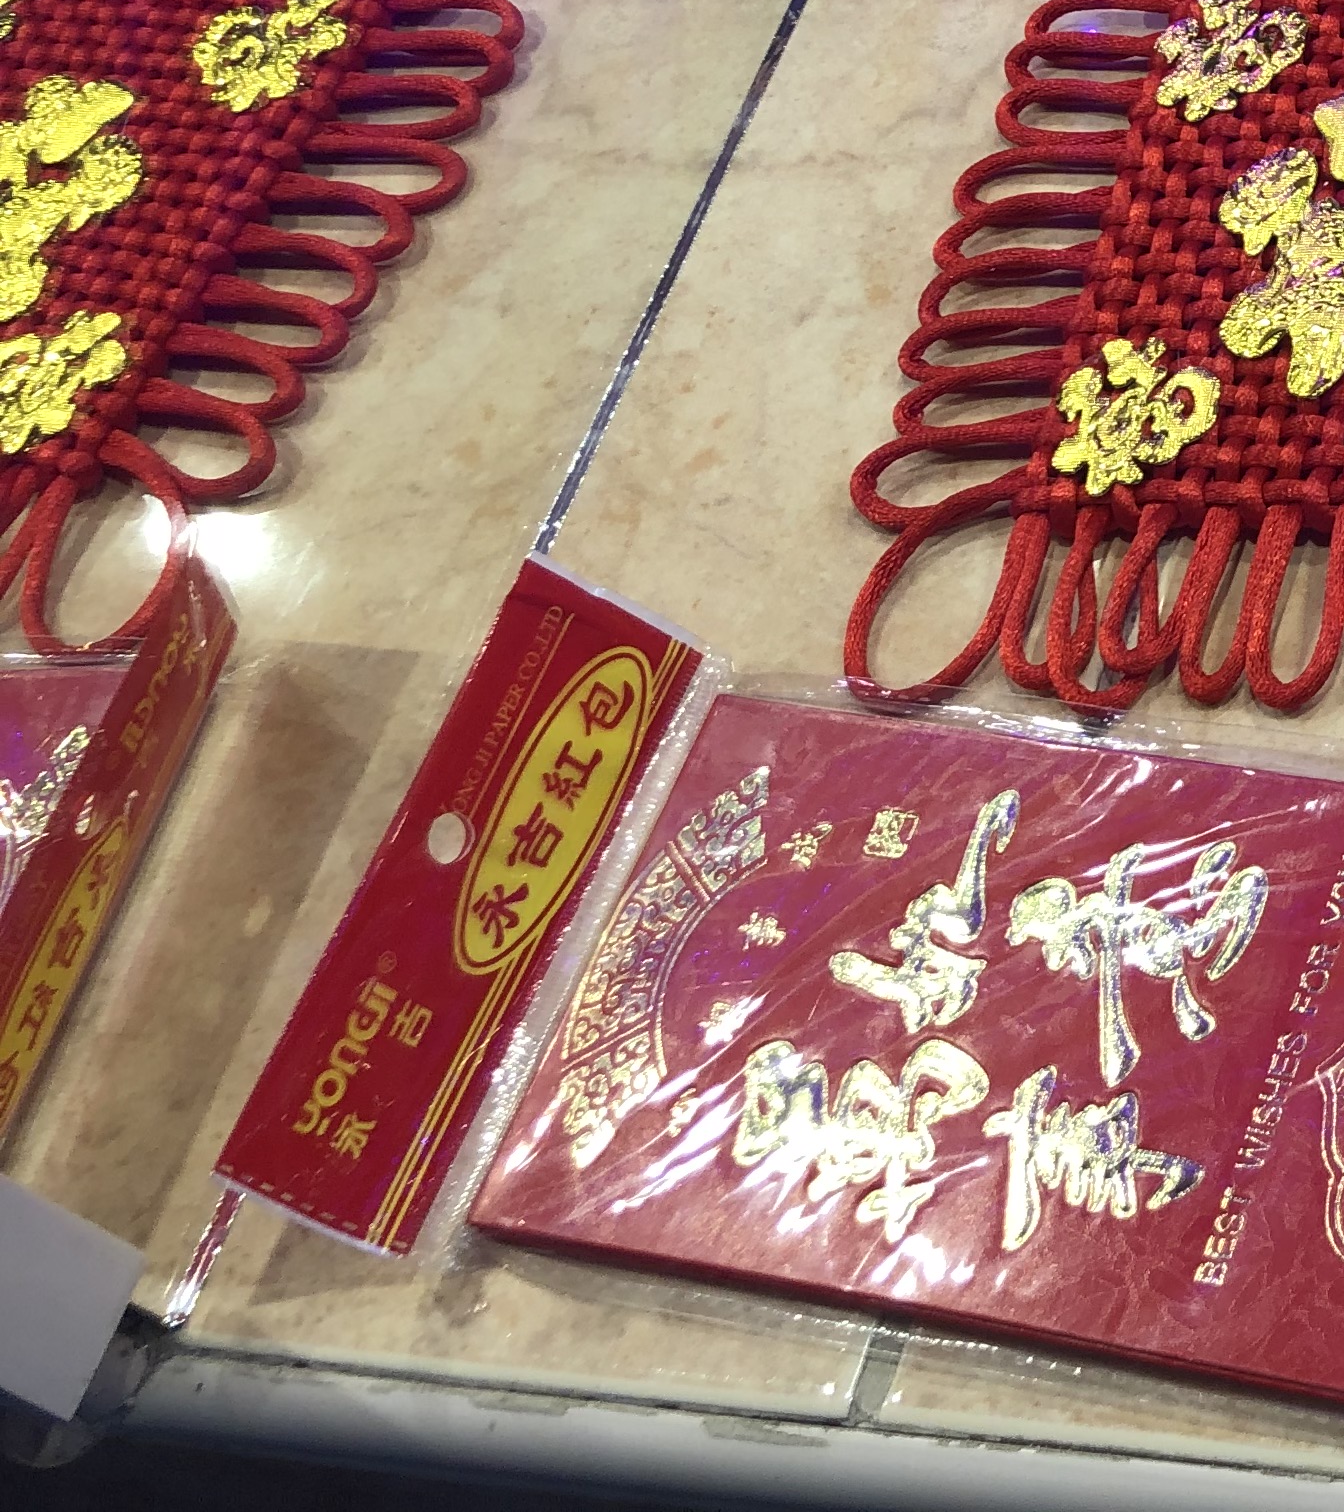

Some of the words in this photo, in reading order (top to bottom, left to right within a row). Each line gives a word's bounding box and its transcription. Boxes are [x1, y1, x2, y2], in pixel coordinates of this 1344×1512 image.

[472, 680, 636, 949] 永吉紅包
[485, 683, 524, 744] PAPER
[1193, 1185, 1252, 1288] BEST
[1234, 1030, 1308, 1170] WISHES
[1288, 941, 1341, 1015] FOR
